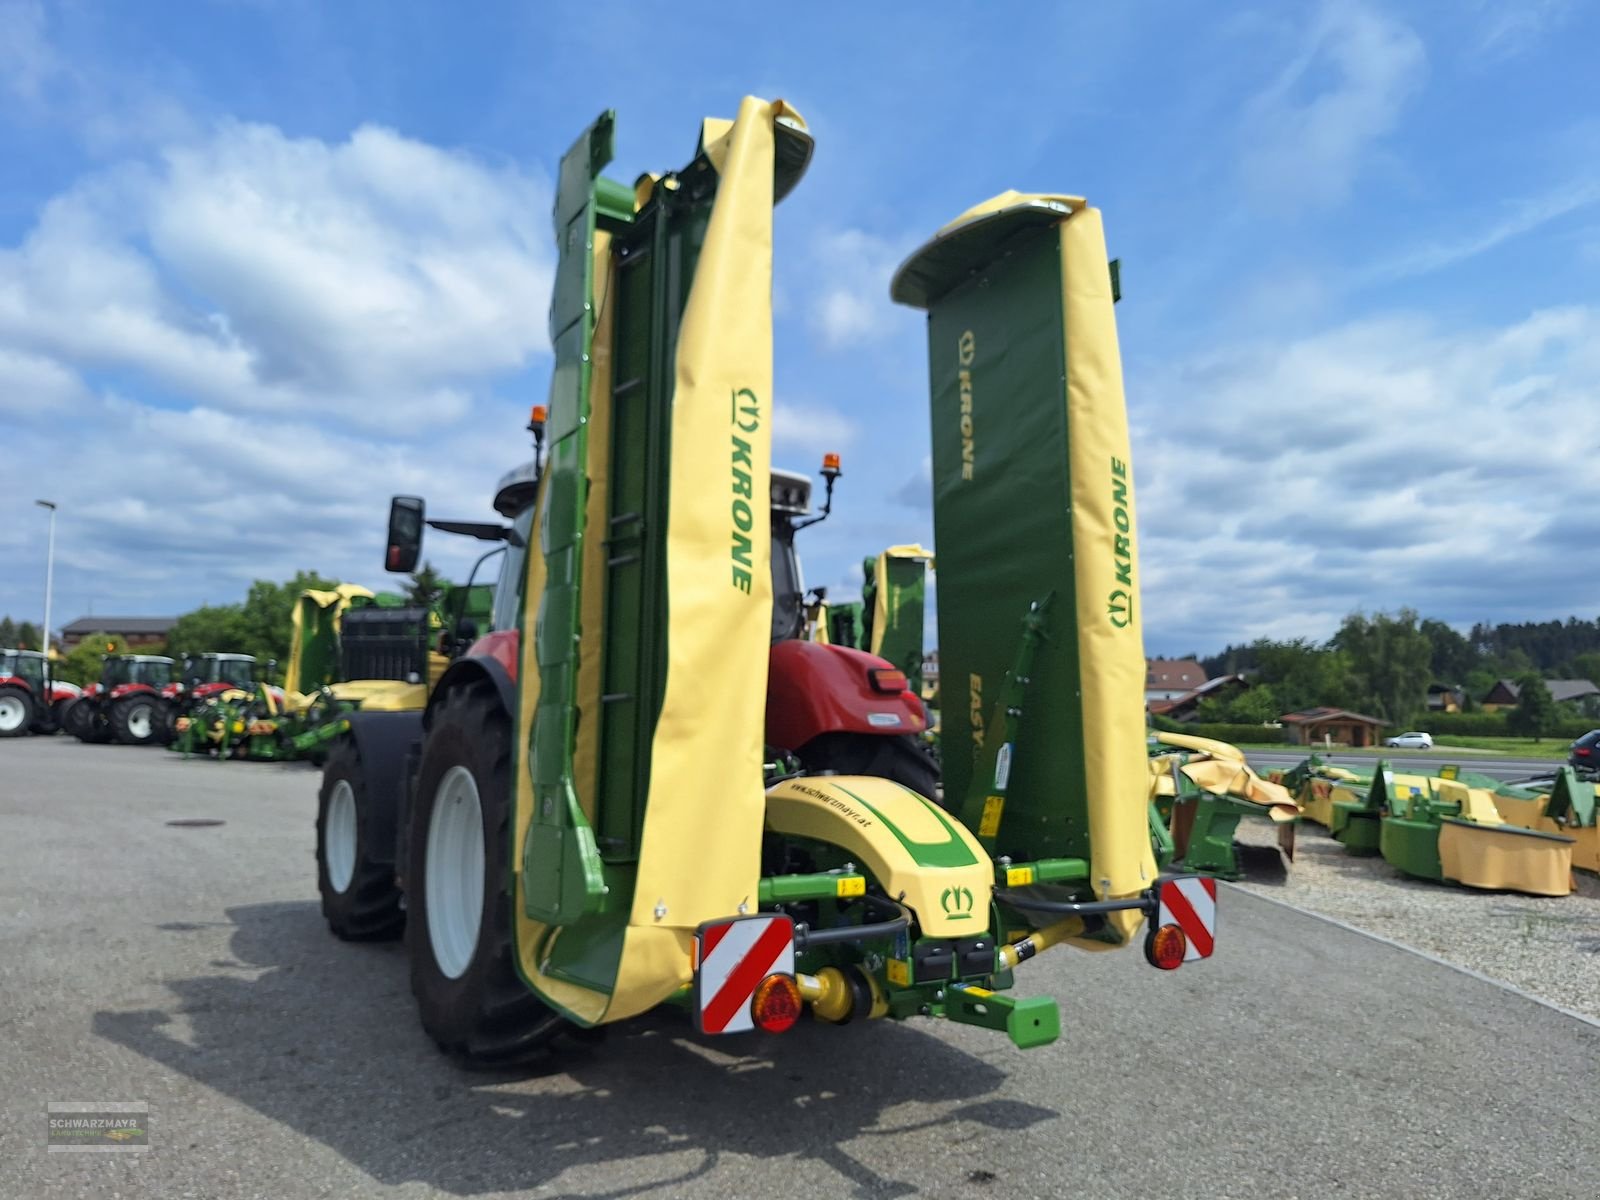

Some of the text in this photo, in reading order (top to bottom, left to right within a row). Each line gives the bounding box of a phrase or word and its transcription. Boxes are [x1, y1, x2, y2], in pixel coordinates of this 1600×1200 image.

[959, 369, 974, 480] KRONE
[732, 435, 752, 595] KRONE
[1111, 456, 1131, 587] KRONE
[970, 673, 984, 747] EASY
